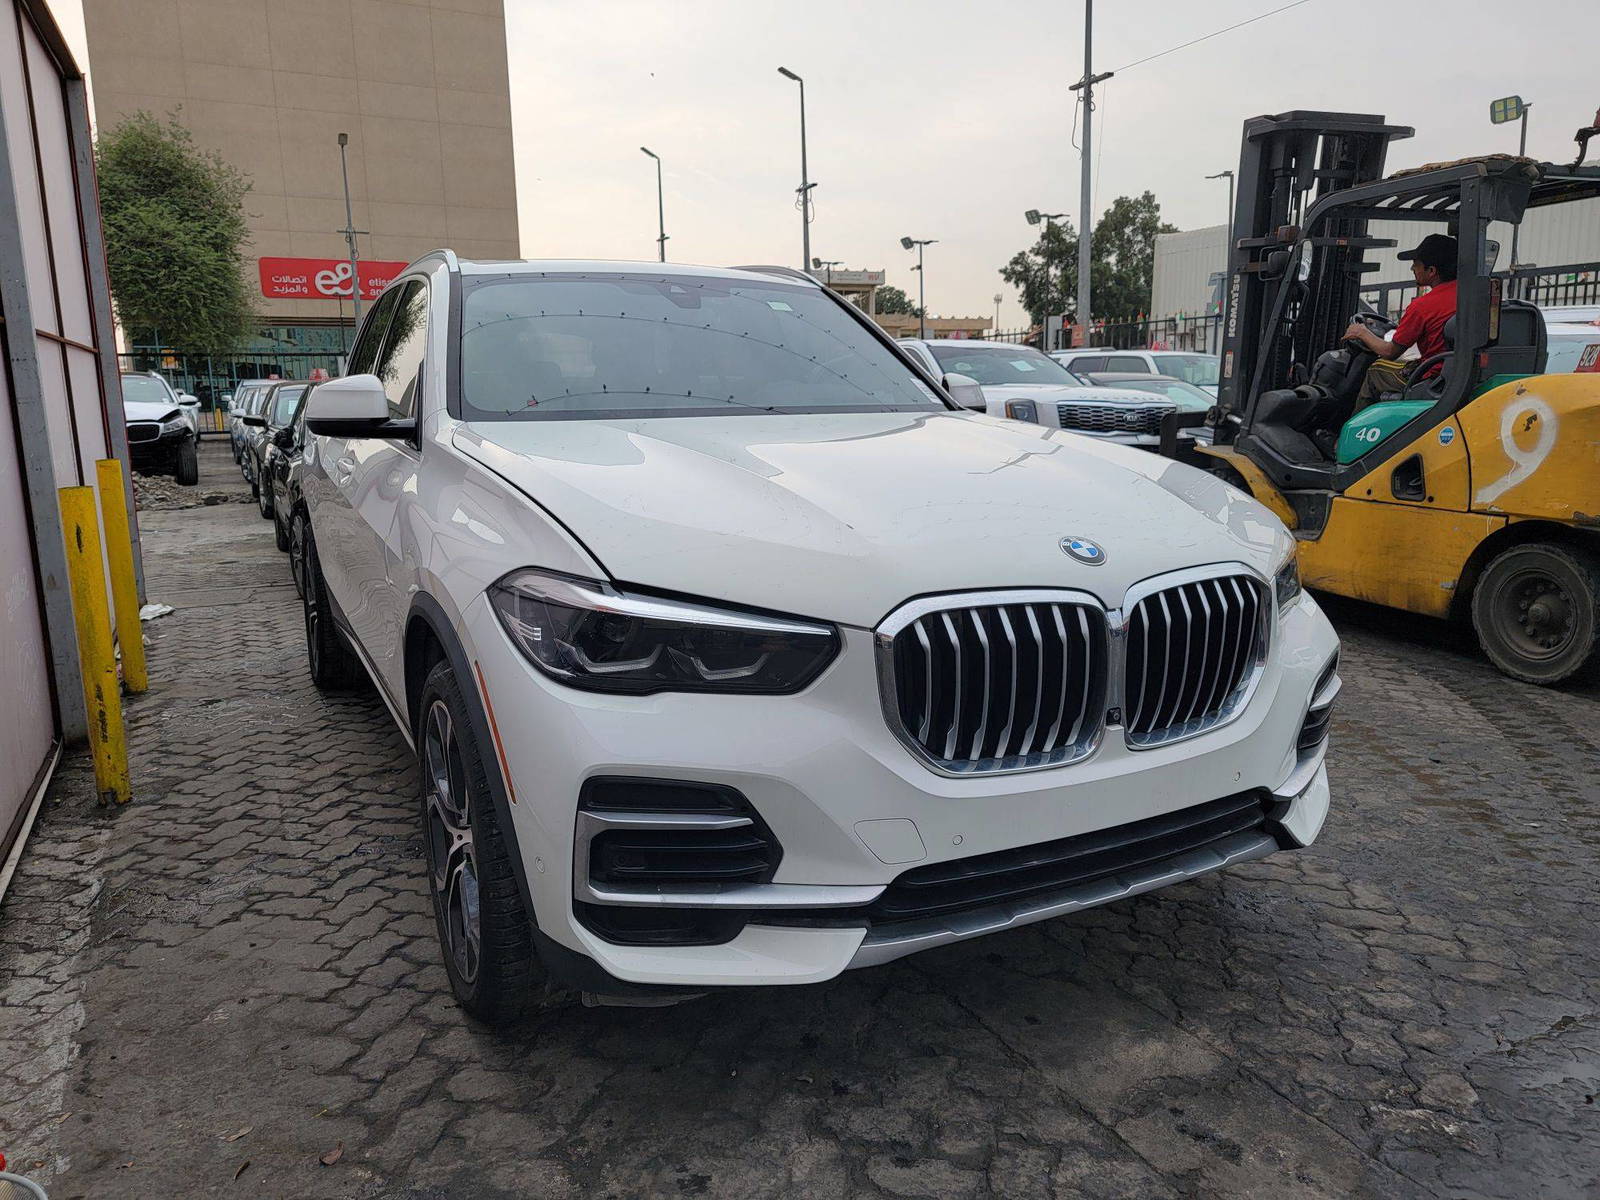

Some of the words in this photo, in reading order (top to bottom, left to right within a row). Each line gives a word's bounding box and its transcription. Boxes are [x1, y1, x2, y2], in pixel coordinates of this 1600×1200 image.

[271, 275, 307, 284] اتصالات
[368, 277, 392, 287] etis
[273, 284, 301, 293] المزيد
[1228, 274, 1240, 338] KOMATSU
[1355, 427, 1381, 442] 40
[1475, 396, 1558, 504] 9
